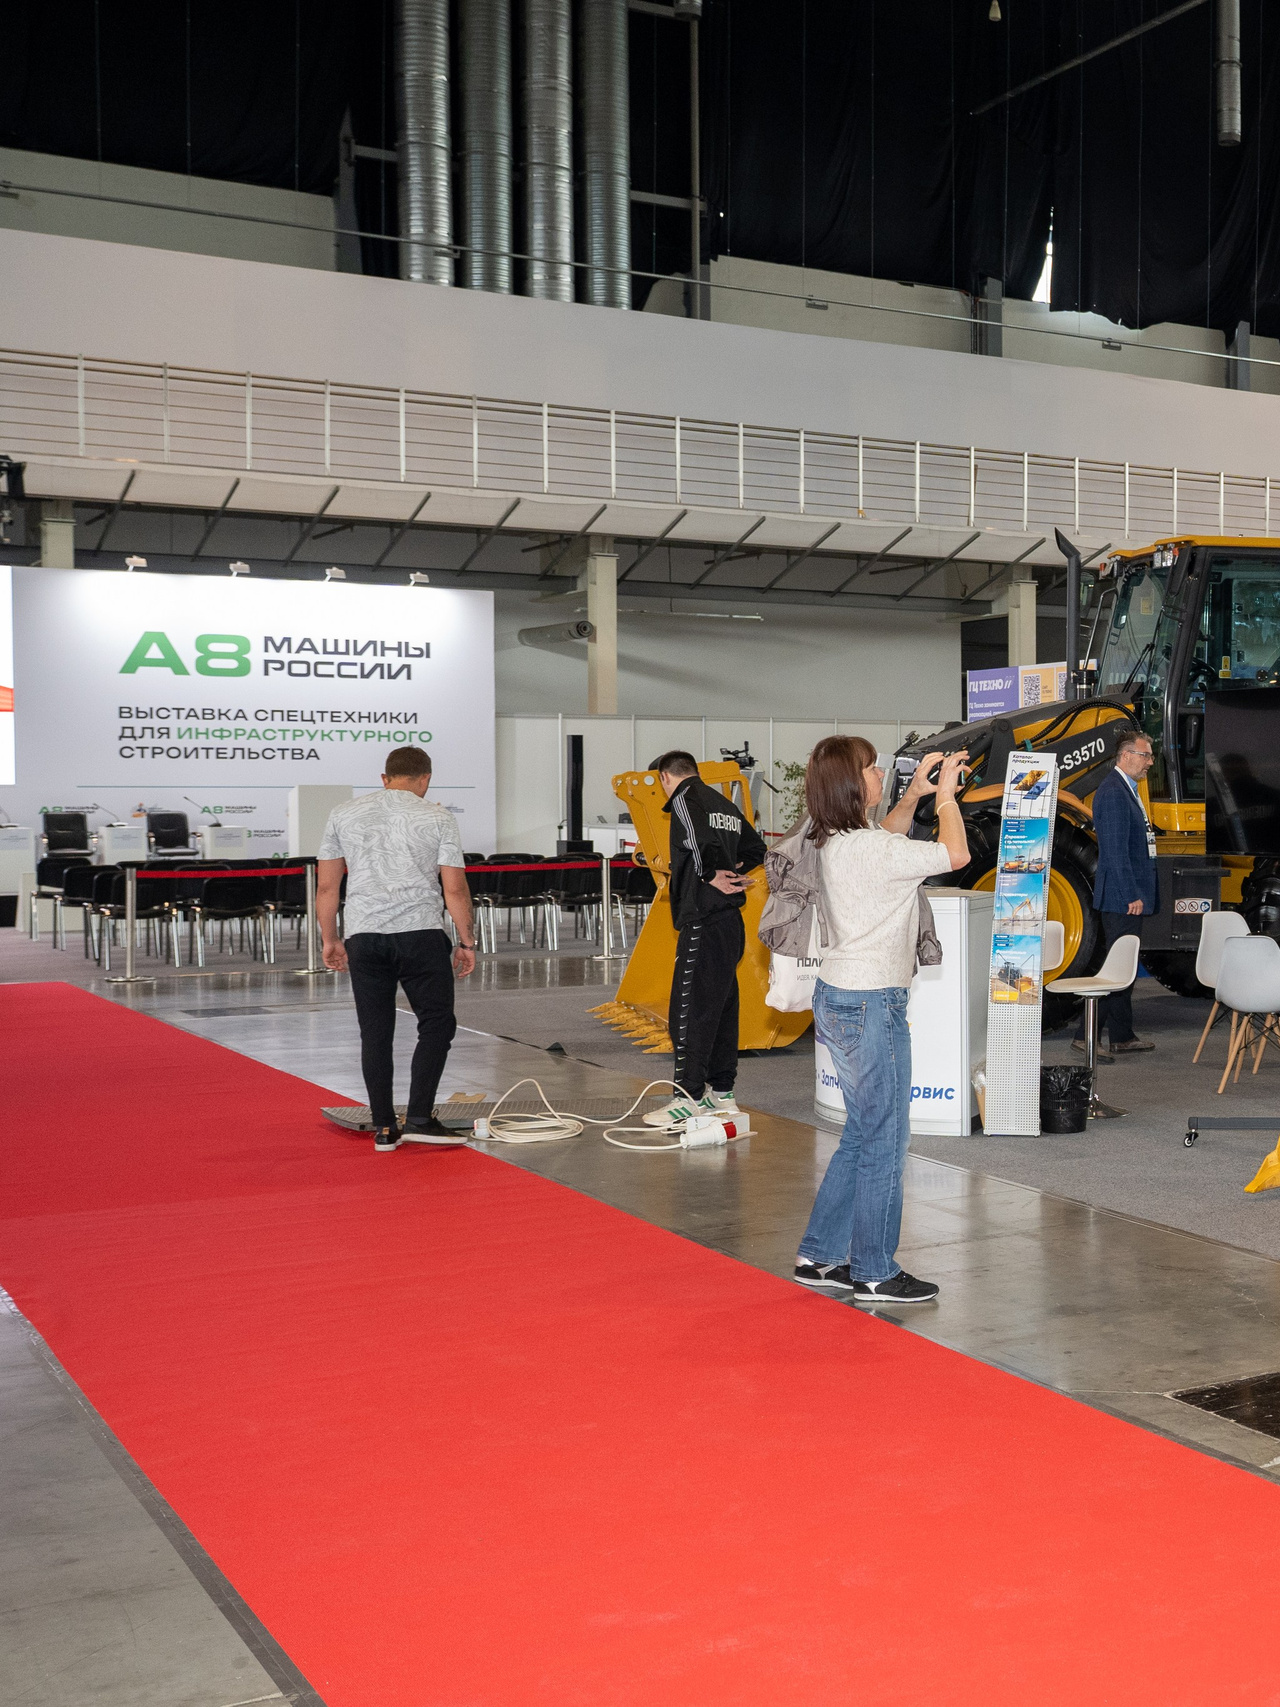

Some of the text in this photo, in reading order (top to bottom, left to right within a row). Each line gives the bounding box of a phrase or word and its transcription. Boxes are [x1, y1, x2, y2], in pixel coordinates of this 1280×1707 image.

[263, 636, 431, 659] МАШИНЫ
[263, 659, 412, 681] РОССИИ
[969, 678, 1003, 694] ГЦ ТЕХНО
[118, 706, 419, 725] ВЫСТАВКА СПЕЦТЕХНИКИ
[118, 726, 433, 743] ДЛЯ ИНФРАСТРУКТУРНОГО
[119, 746, 320, 761] СТРОИТЕЛЬСТВА
[1056, 737, 1106, 771] -S3570
[821, 1069, 955, 1102] Запч рвис
